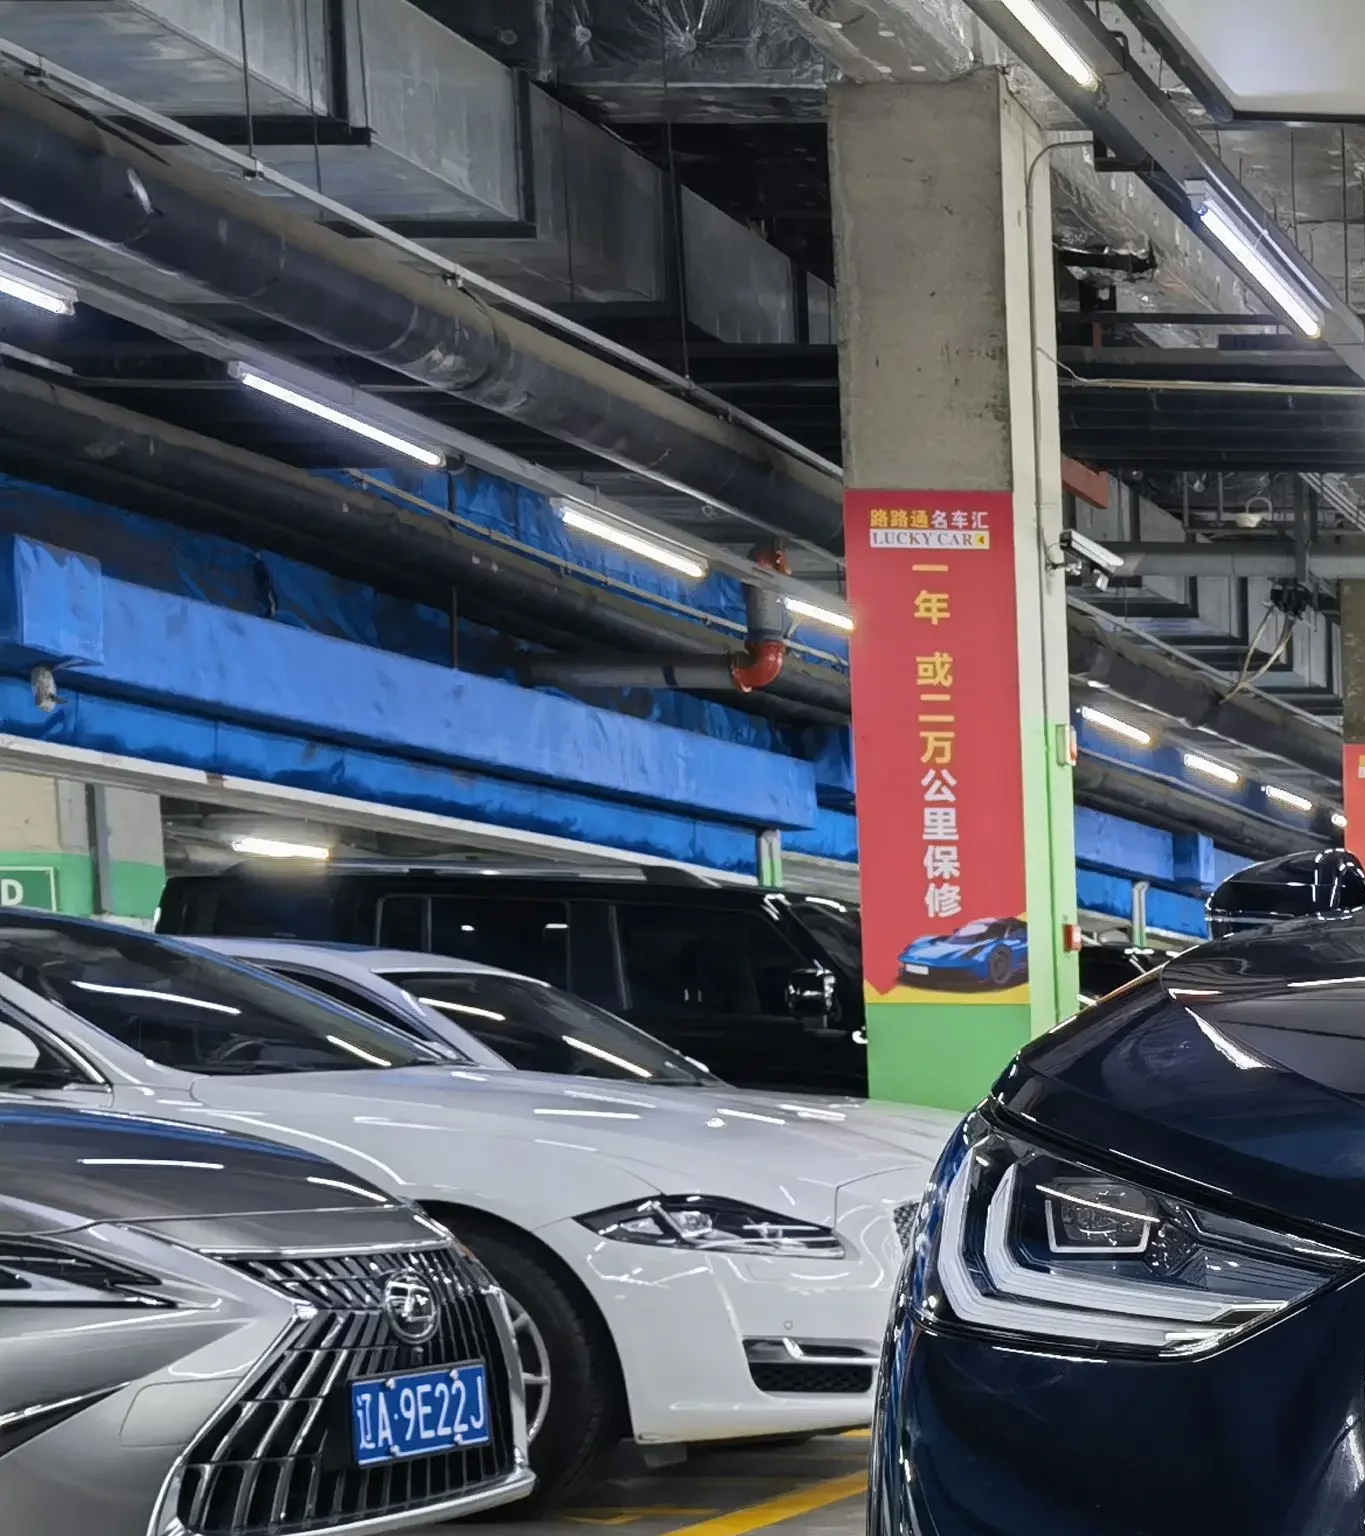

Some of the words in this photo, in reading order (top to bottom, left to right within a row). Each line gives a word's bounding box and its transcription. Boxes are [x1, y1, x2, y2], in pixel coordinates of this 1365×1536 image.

[870, 508, 989, 528] 路路通名车汇
[872, 532, 933, 545] LUCKY
[937, 532, 973, 546] CAR
[1, 879, 23, 905] D
